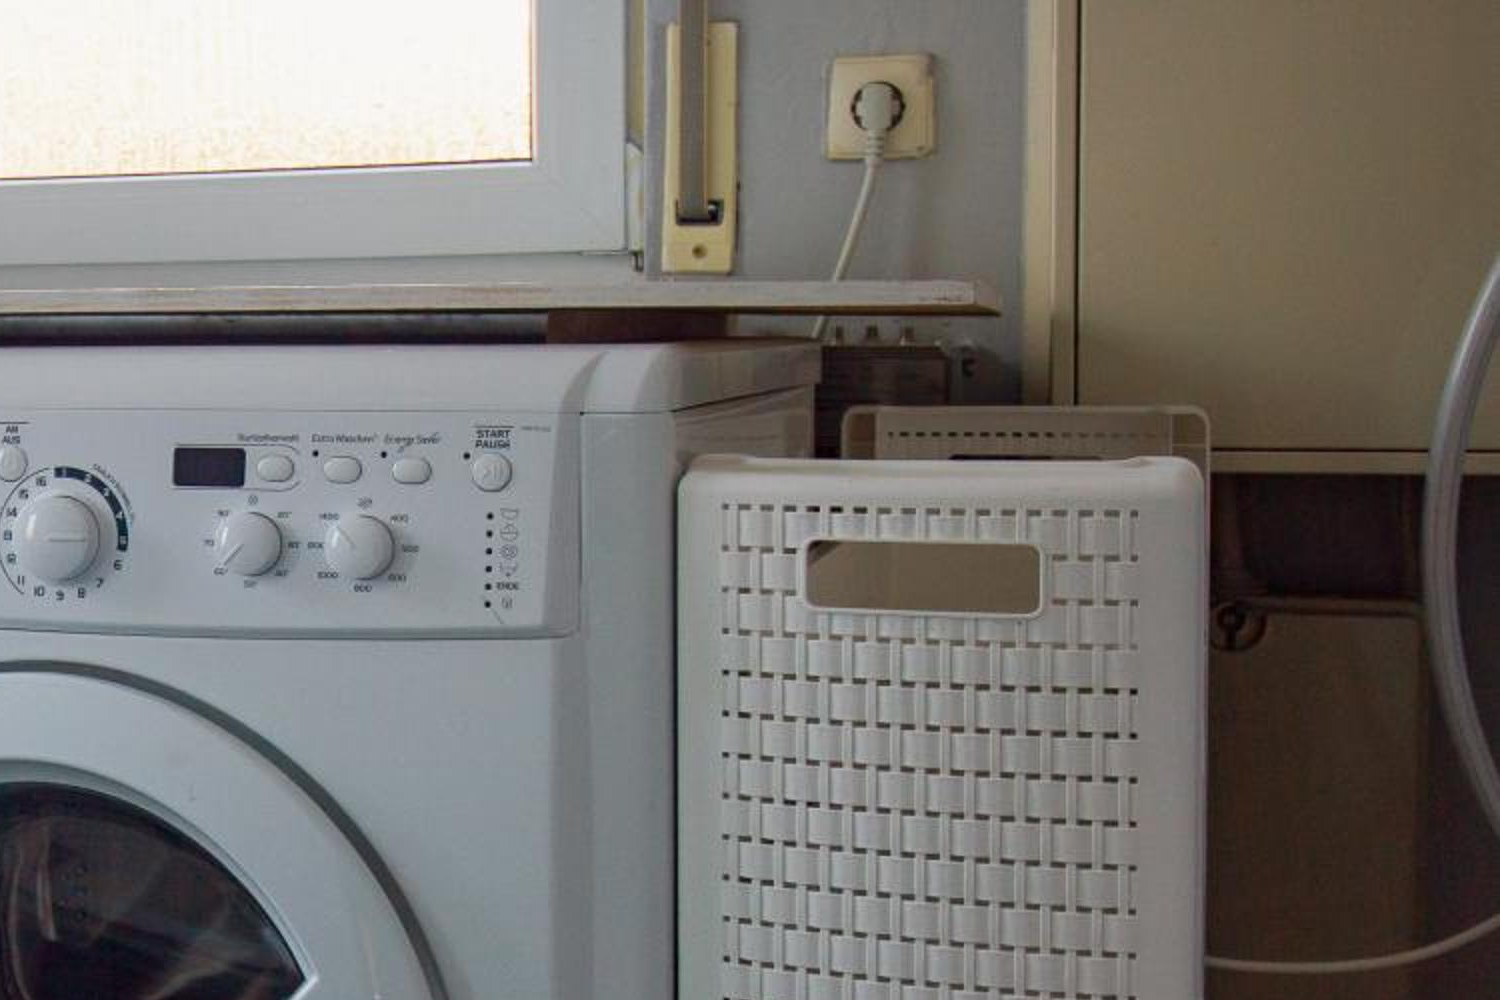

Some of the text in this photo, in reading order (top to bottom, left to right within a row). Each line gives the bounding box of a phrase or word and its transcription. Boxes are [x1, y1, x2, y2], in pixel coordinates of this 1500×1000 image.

[476, 429, 511, 439] START
[2, 435, 21, 445] AUS
[475, 440, 510, 450] PAUSE
[36, 476, 47, 487] 16
[6, 507, 18, 518] 14
[113, 559, 123, 570] 6
[17, 575, 25, 585] 11
[95, 577, 104, 588] 7
[33, 586, 45, 597] 10
[496, 581, 519, 591] ENDE
[55, 589, 64, 601] 9
[78, 587, 86, 598] 8
